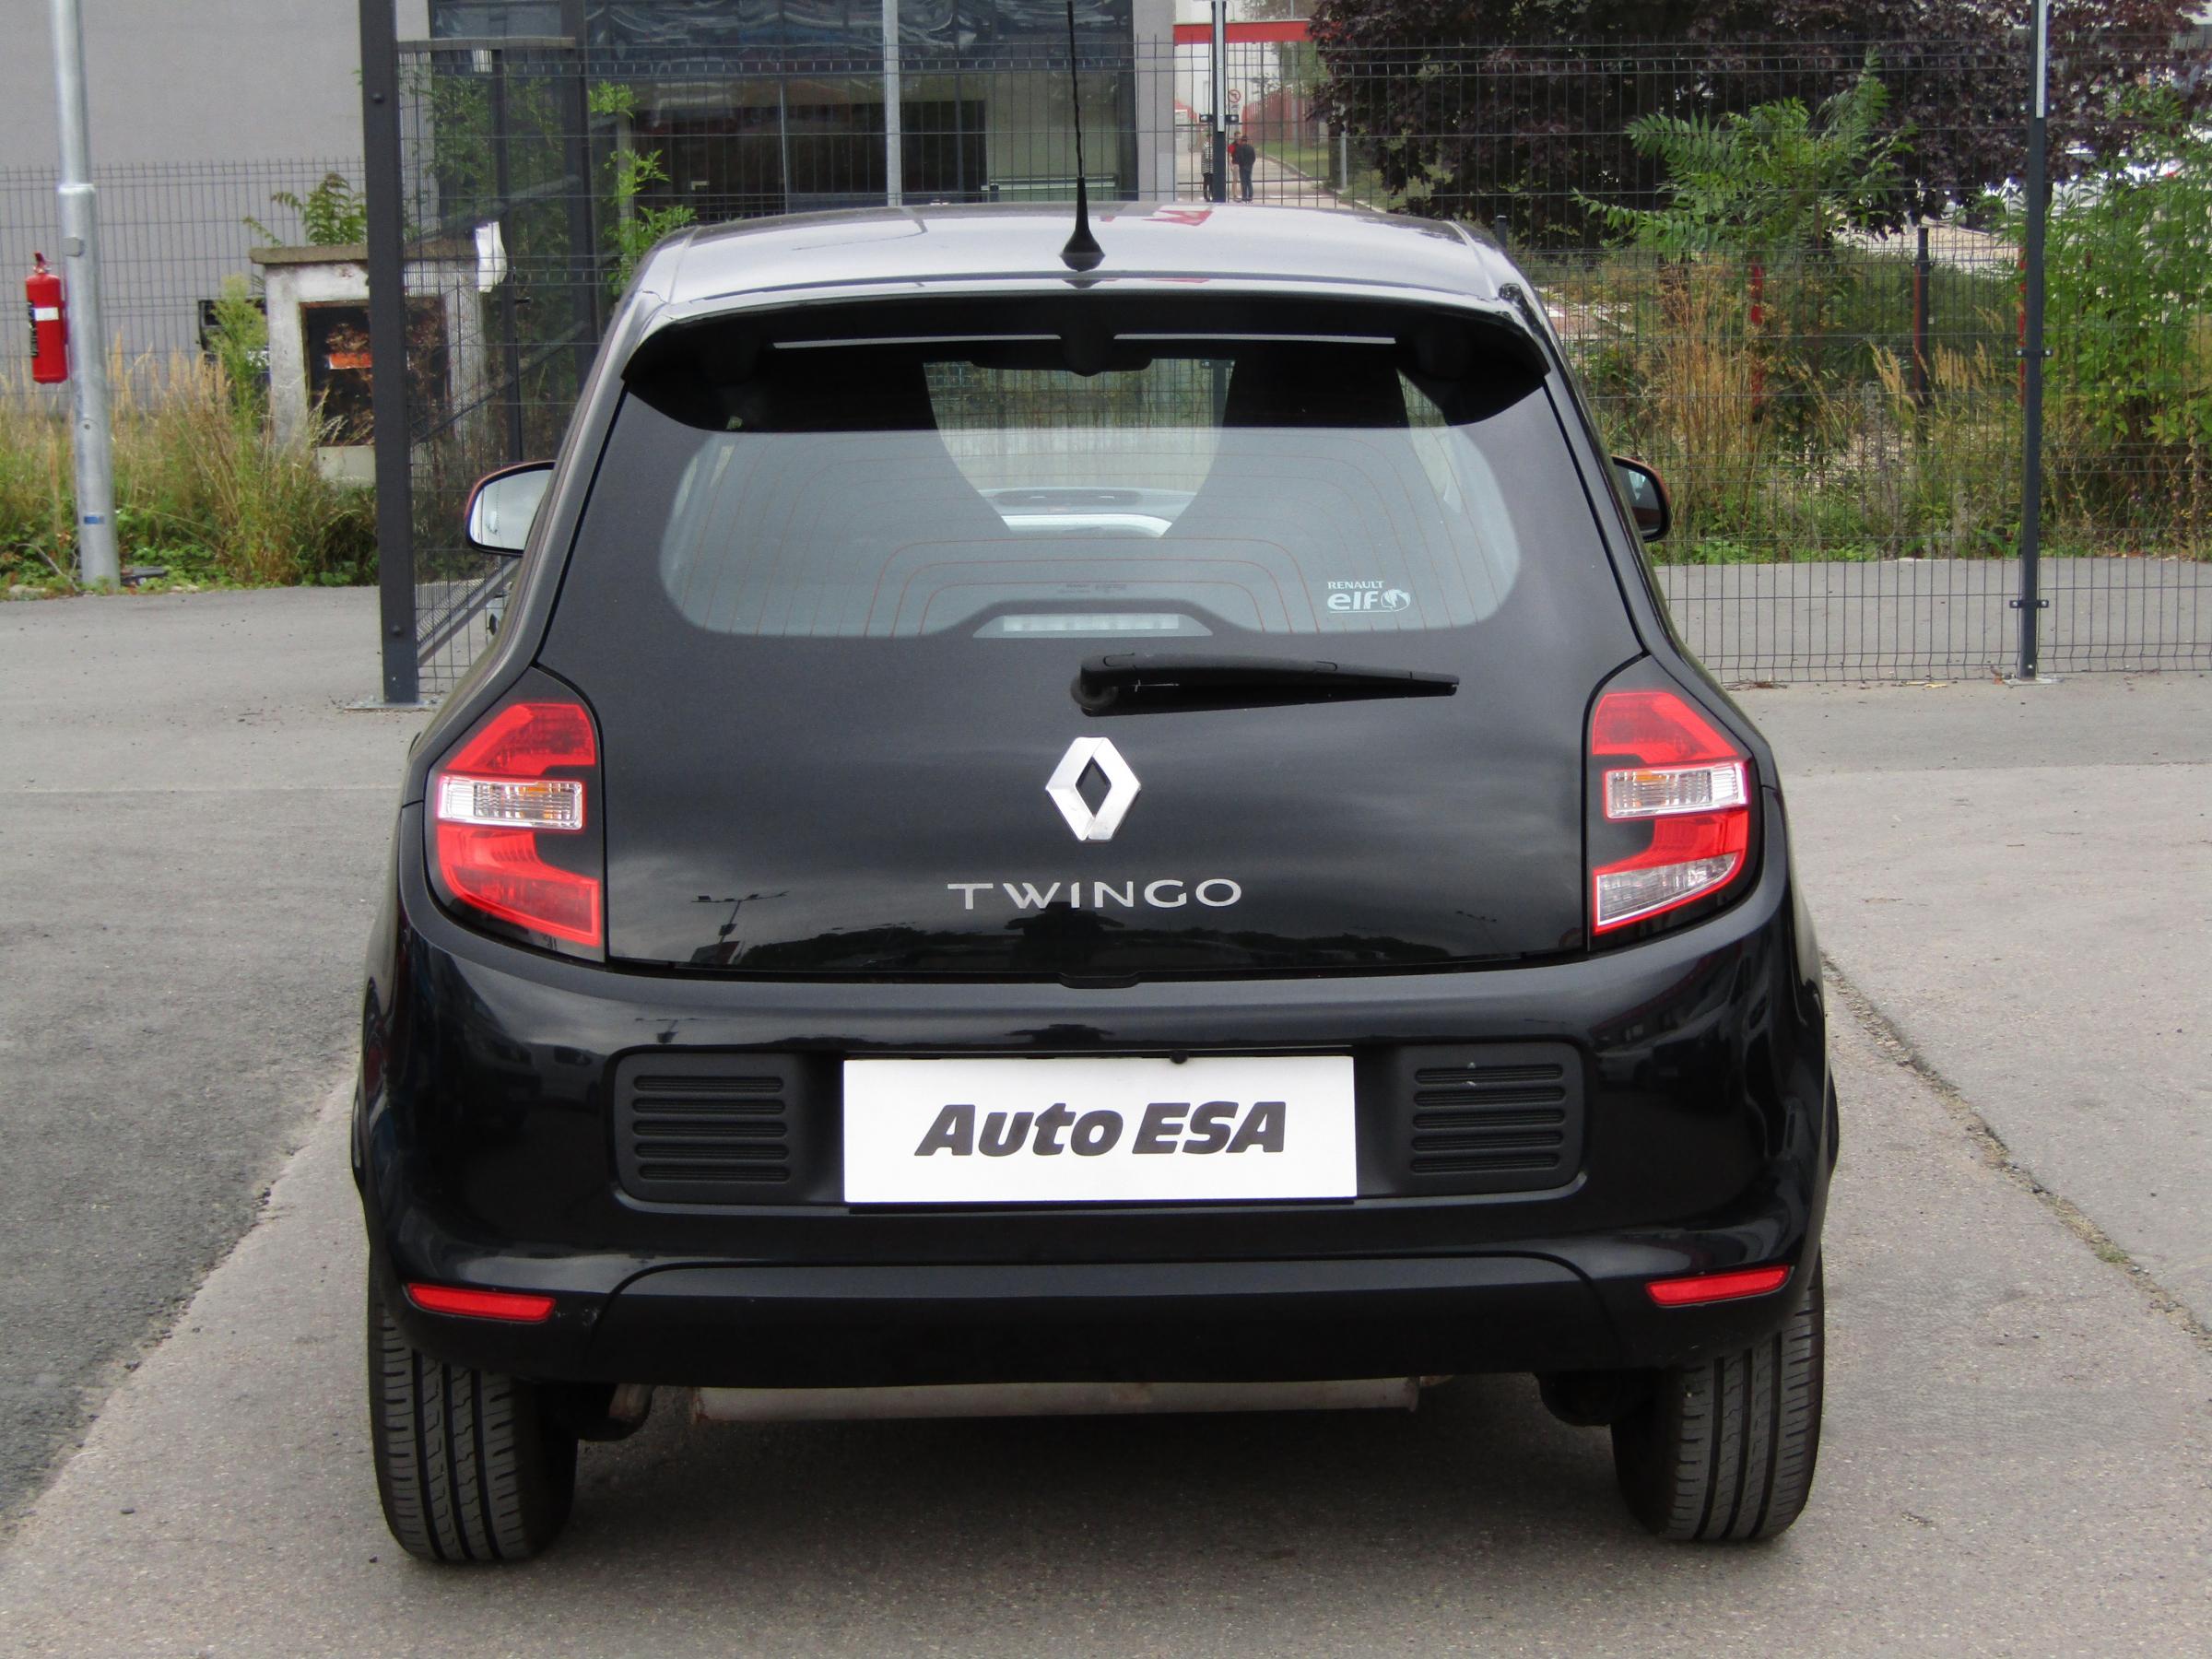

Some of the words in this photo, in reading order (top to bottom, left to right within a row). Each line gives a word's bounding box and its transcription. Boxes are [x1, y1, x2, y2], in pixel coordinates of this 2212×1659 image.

[1327, 581, 1384, 589] RENAULT
[1327, 591, 1379, 610] elf
[947, 878, 1241, 910] TWINGO
[914, 1102, 1124, 1157] Auto
[1132, 1100, 1287, 1155] ESA
